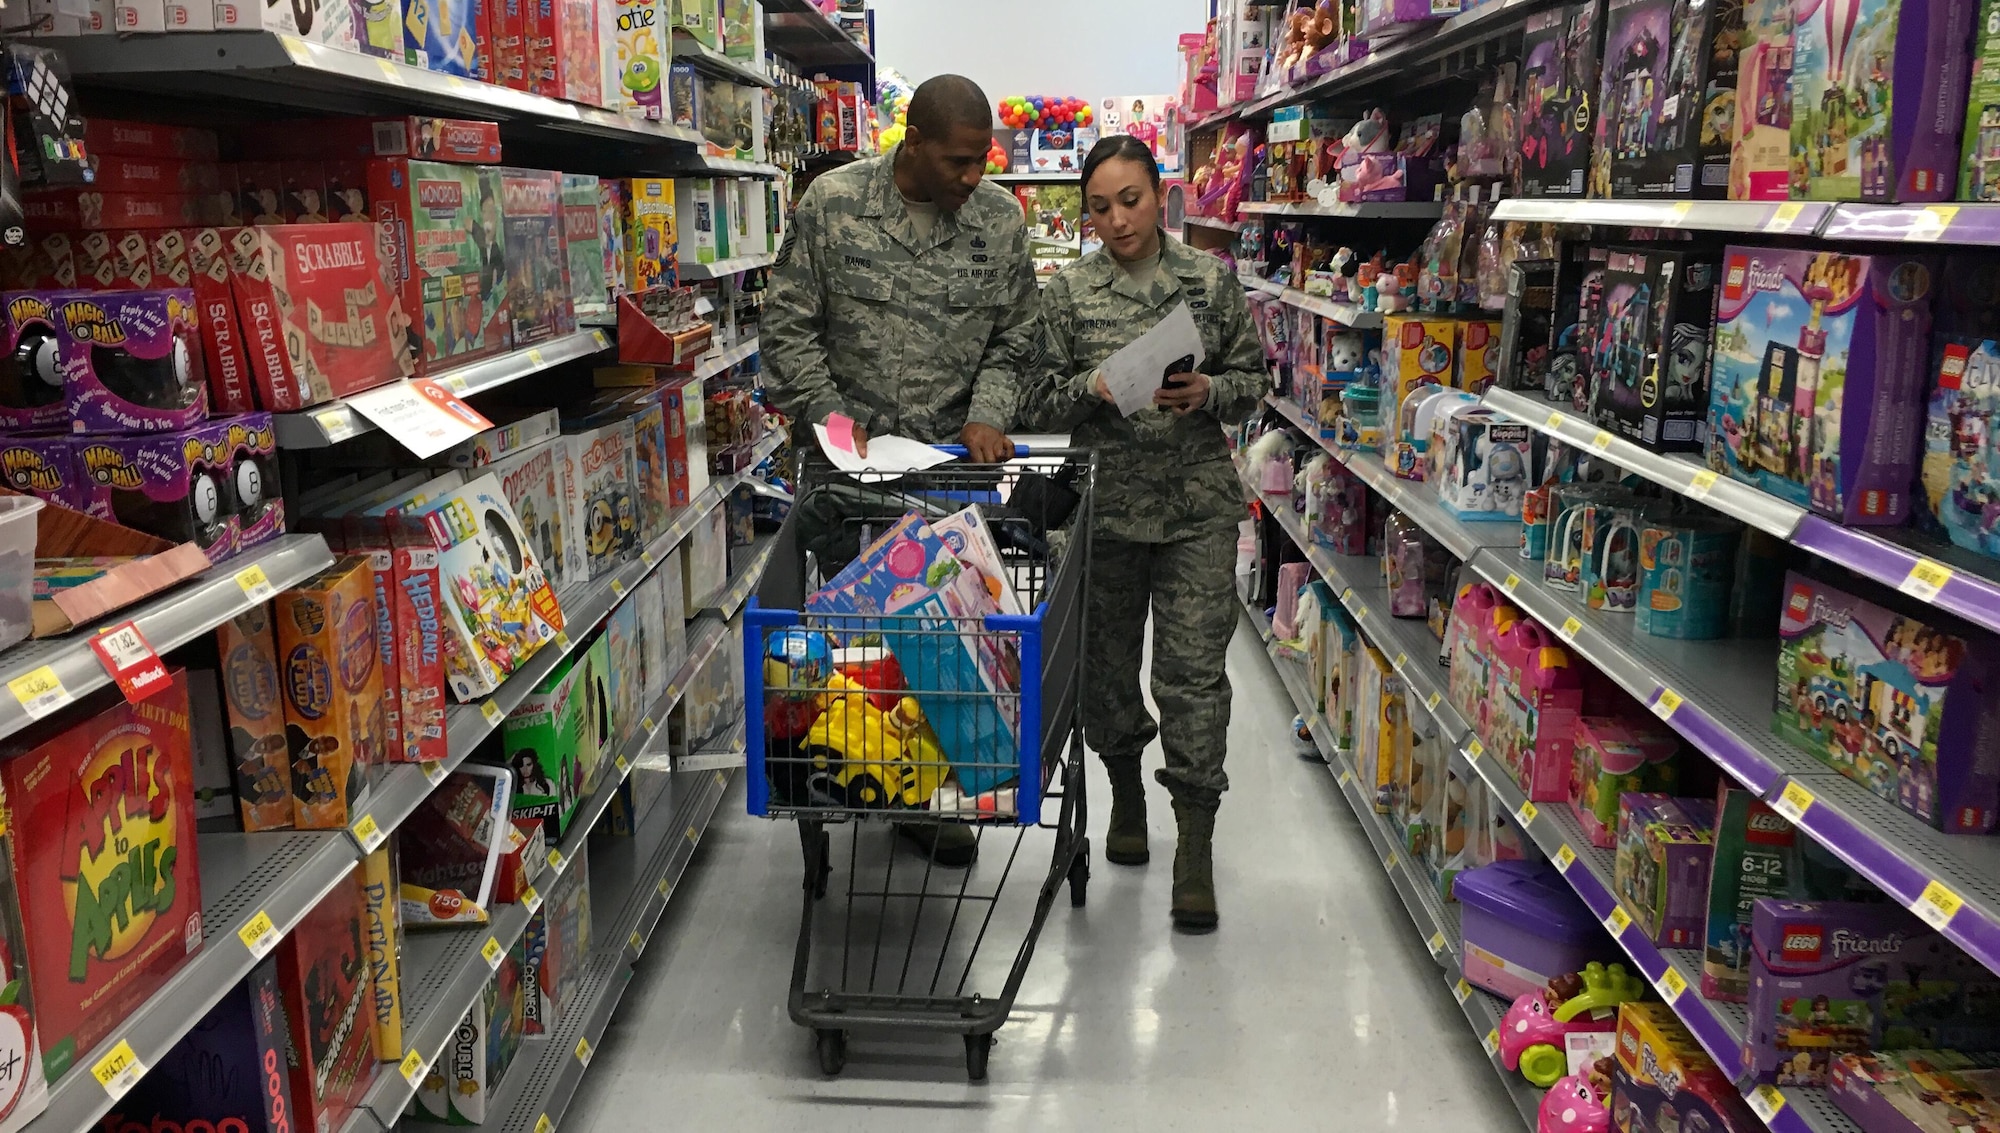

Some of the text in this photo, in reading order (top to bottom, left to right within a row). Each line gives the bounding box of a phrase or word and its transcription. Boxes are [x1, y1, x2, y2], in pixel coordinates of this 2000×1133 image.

[1934, 63, 1949, 134] ADVERTENCIA
[448, 130, 484, 145] MONOPOLY
[420, 185, 460, 204] MONOPOLY
[505, 184, 550, 211] MONOPOLY
[296, 240, 366, 274] SCRABBLE
[844, 255, 872, 269] BANKS
[1035, 247, 1069, 255] ULTIMATE SPEED
[956, 268, 1000, 279] U.S. AIR FORCE
[1727, 258, 1784, 292] LEGO Friends
[11, 300, 46, 326] MAGIC
[64, 304, 105, 325] MAGIC
[120, 304, 167, 328] Reply Hazy
[92, 320, 126, 344] BALL
[120, 313, 157, 338] Try Again
[208, 303, 242, 401] SCRABBLE
[250, 302, 289, 401] SCRABBLE
[118, 413, 141, 430] Point
[142, 418, 154, 431] To
[157, 417, 174, 430] Yes
[498, 428, 520, 453] LIFE
[3, 449, 43, 472] MAGIC
[84, 448, 124, 471] MAGIC
[136, 449, 182, 472] Reply Hazy
[582, 432, 624, 477] TROUBLE
[30, 467, 62, 489] BALL
[111, 467, 144, 488] BALL
[136, 458, 173, 481] Try Again
[249, 471, 259, 494] 8
[207, 488, 215, 511] 8
[1867, 490, 1879, 514] LEGO
[430, 499, 478, 551] LIFE
[401, 572, 438, 667] HEDBANZ
[1811, 594, 1851, 630] Friends
[130, 665, 165, 689] Rollback
[290, 656, 310, 708] FEUD
[131, 703, 189, 732] PARTY BOX
[507, 714, 550, 732] MOVES
[77, 751, 93, 777] OVER
[117, 723, 137, 736] GAMES
[61, 745, 171, 878] APPLES
[512, 804, 554, 820] SKIP-IT
[1749, 812, 1790, 834] LEGO
[114, 836, 129, 855] to
[1741, 856, 1782, 876] 6-12
[69, 838, 178, 982] APPLES
[434, 894, 462, 908] 750
[363, 880, 394, 1026] PICTIONARY
[1784, 929, 1902, 960] LEGO Friends
[79, 995, 92, 1011] The
[92, 982, 111, 1000] Game
[524, 964, 539, 1020] CONNECT
[101, 1054, 127, 1082] $14.77
[1621, 1030, 1679, 1101] LEGO Friends
